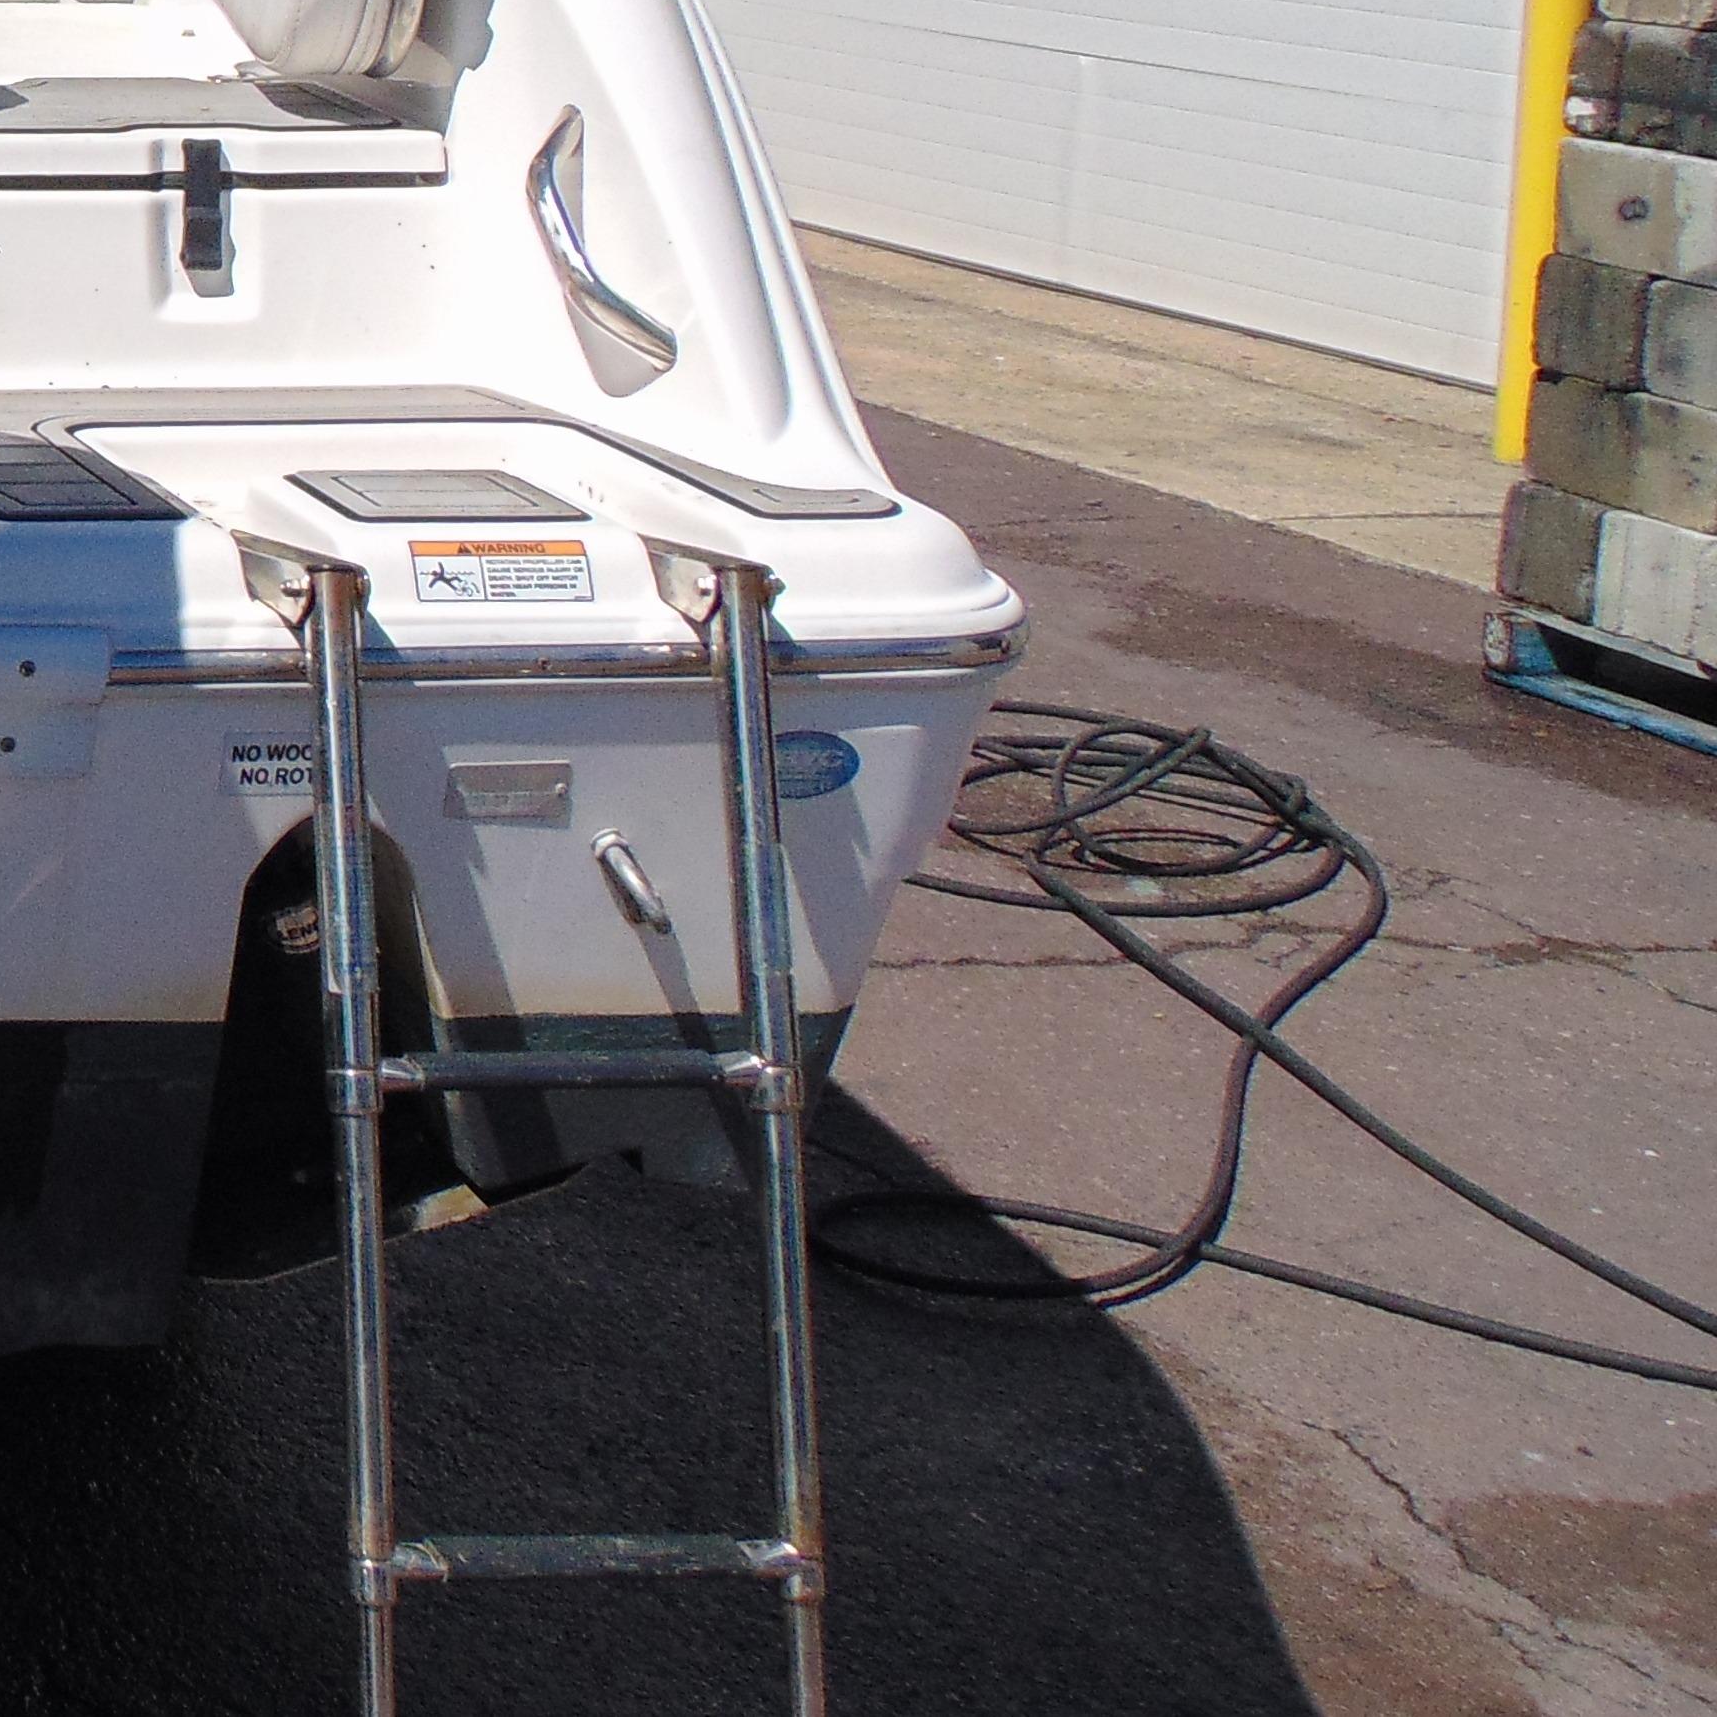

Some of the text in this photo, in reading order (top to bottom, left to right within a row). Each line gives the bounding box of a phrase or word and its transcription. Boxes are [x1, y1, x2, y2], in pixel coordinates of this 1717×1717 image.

[472, 543, 546, 554] WARNING
[232, 744, 312, 762] NO WOO
[240, 768, 269, 784] NO
